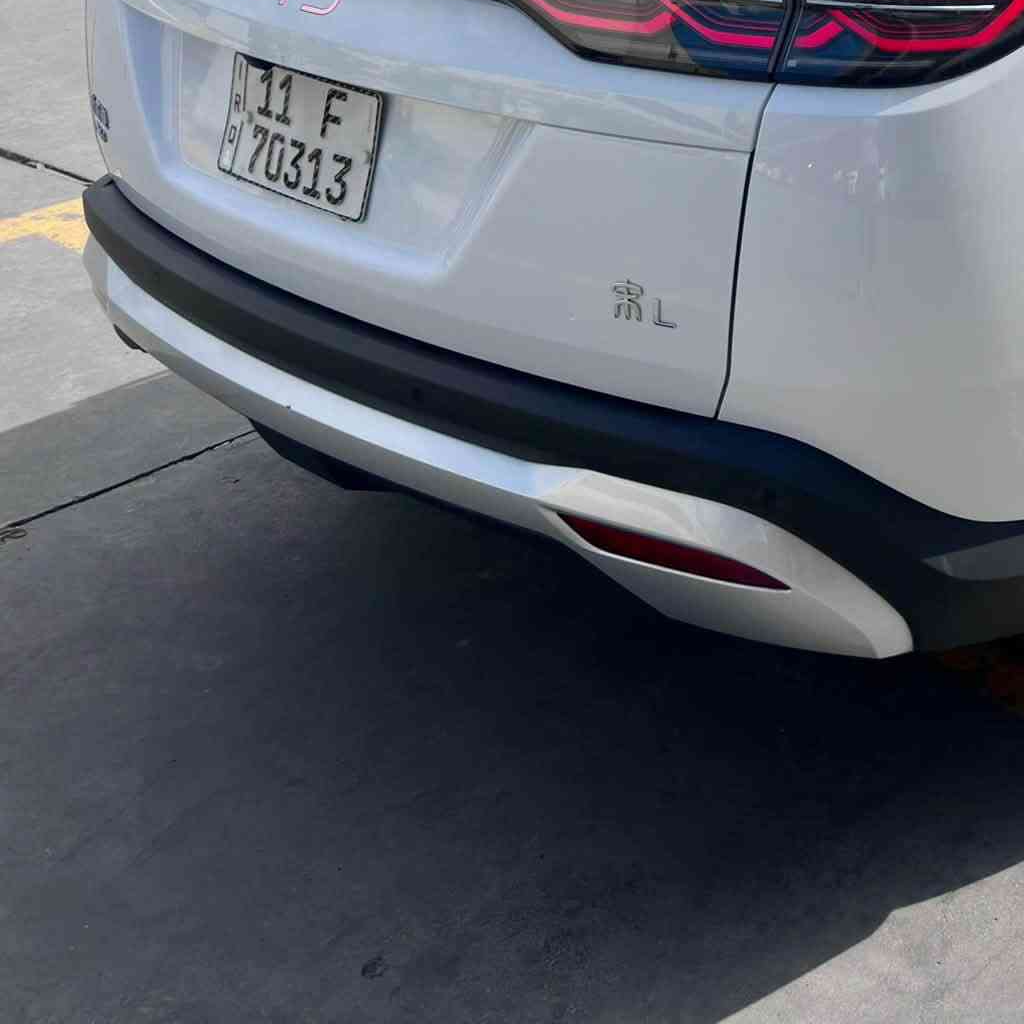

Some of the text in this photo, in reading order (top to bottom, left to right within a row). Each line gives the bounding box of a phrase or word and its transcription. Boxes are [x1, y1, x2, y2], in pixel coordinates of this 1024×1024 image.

[257, 69, 348, 138] 11 F
[248, 124, 352, 205] 70313
